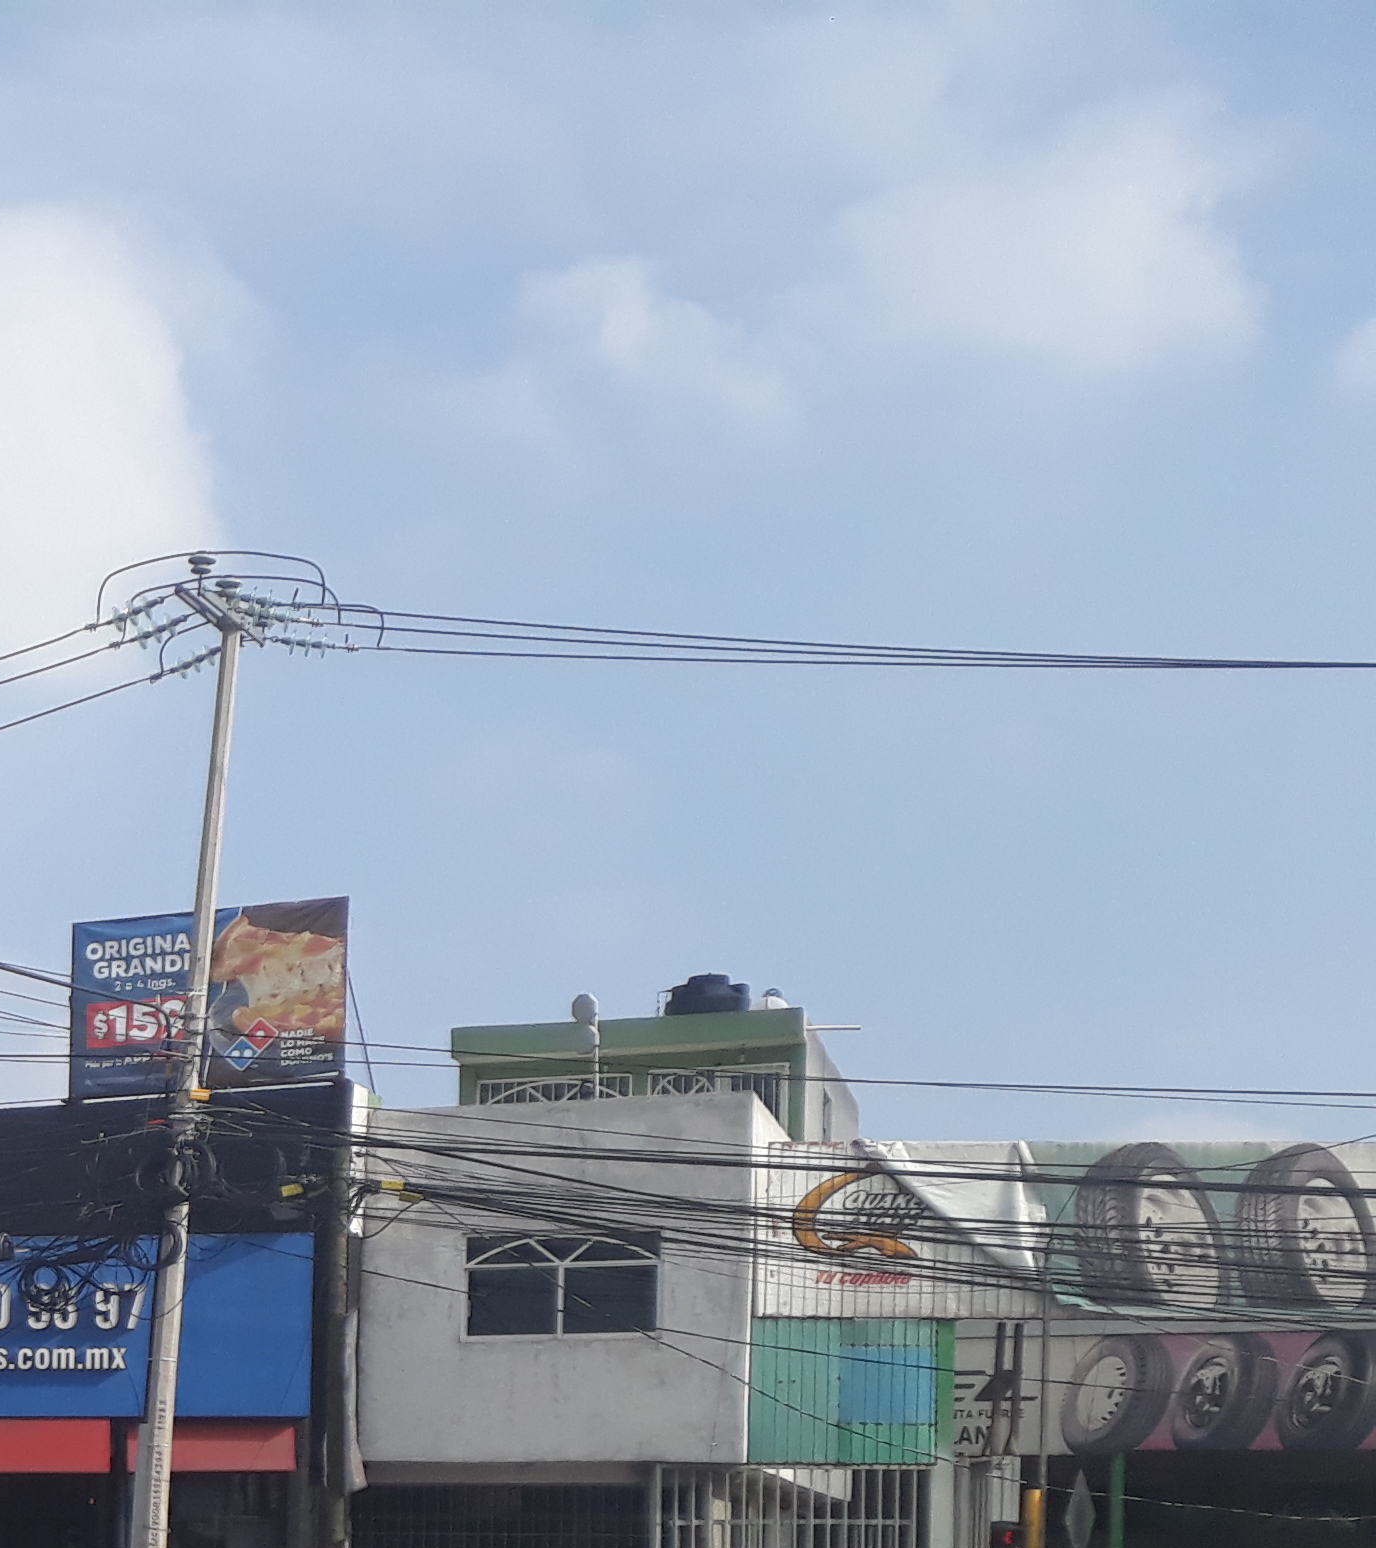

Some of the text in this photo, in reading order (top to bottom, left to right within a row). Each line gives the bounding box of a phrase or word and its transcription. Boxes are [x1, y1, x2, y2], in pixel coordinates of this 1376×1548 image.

[85, 932, 191, 961] ORIGINA
[281, 1028, 314, 1037] NADIE
[281, 1039, 294, 1048] LO
[281, 1047, 313, 1058] COMO
[95, 1282, 148, 1330] 97
